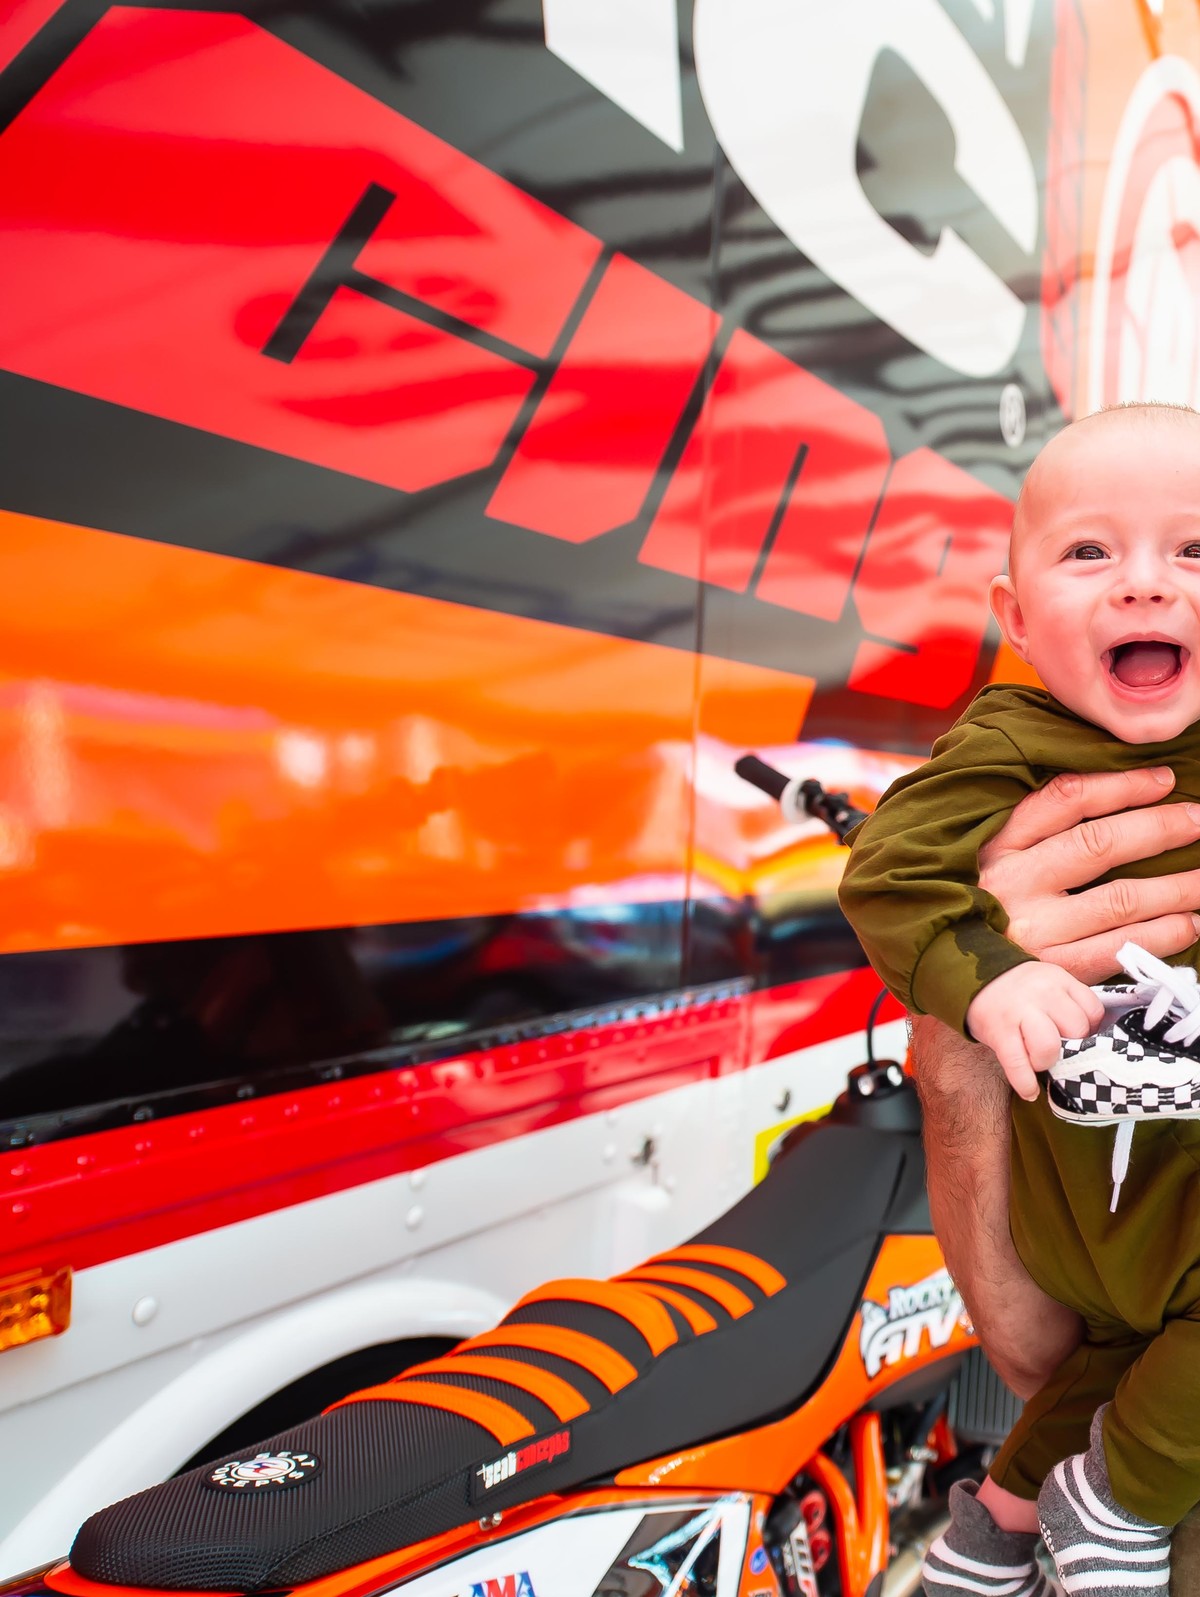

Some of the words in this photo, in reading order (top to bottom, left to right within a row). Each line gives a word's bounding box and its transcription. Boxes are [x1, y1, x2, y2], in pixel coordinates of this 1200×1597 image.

[865, 1299, 964, 1378] ATV
[254, 1451, 315, 1467] SEAT
[201, 1461, 305, 1487] CONCEPTS
